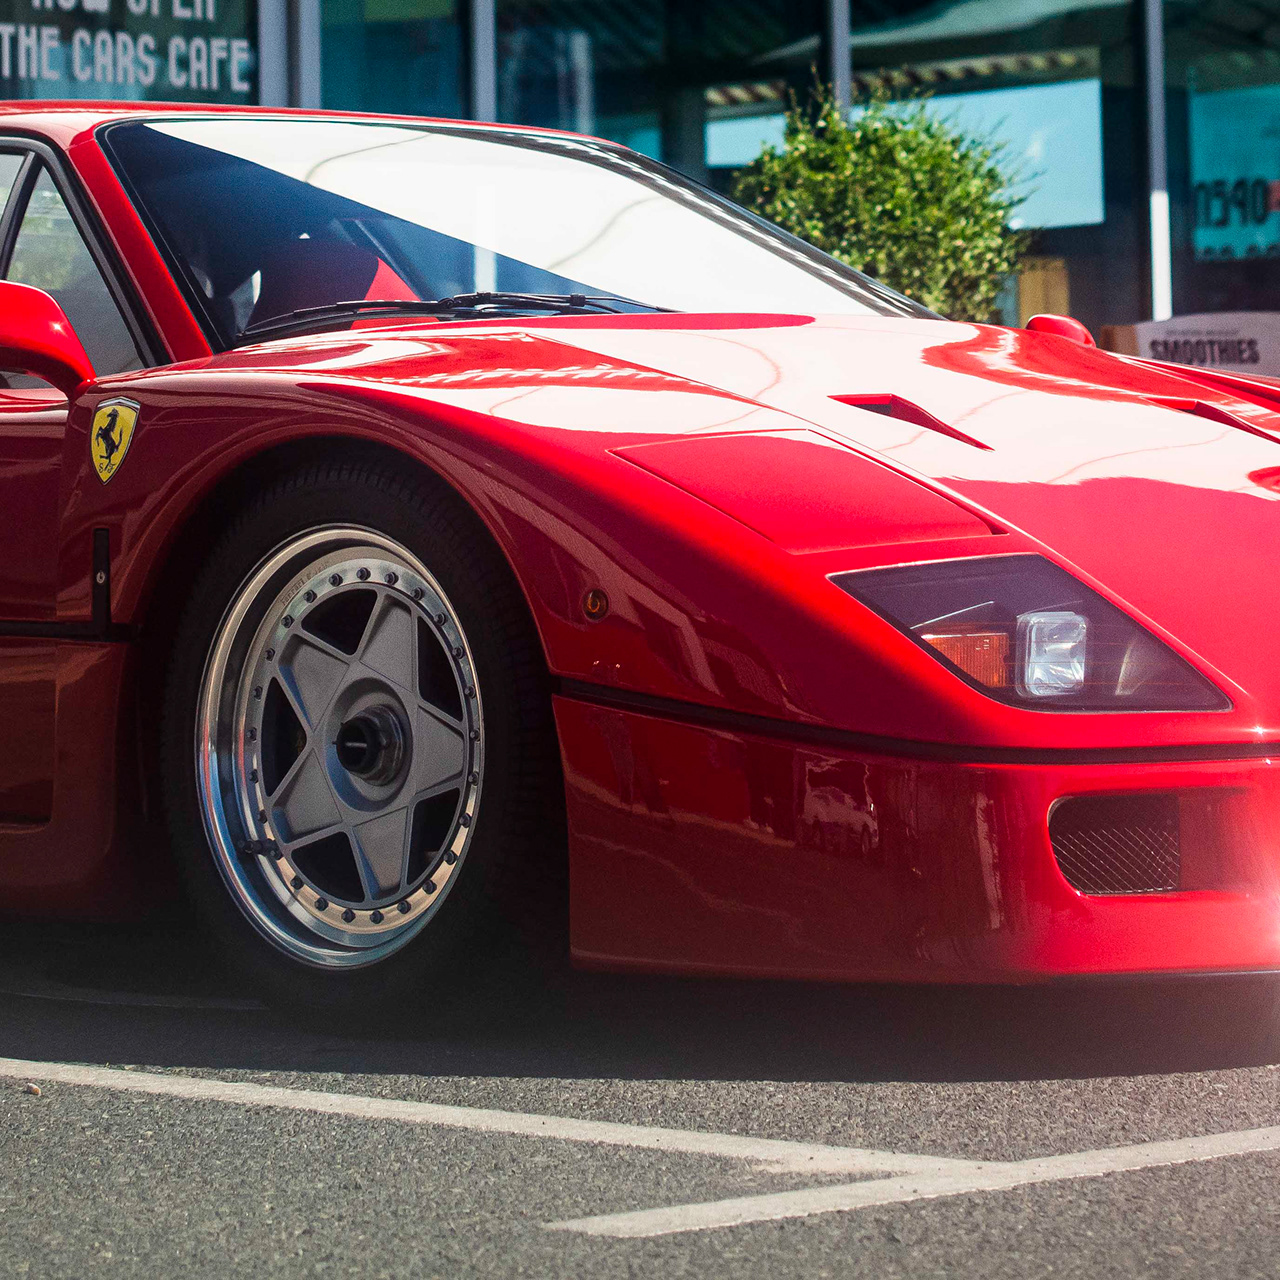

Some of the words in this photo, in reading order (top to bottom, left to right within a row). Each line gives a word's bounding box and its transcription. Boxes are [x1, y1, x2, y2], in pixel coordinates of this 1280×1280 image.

[71, 28, 158, 87] CARS
[168, 36, 251, 93] CAFE
[1150, 337, 1261, 366] SMOOTHIES
